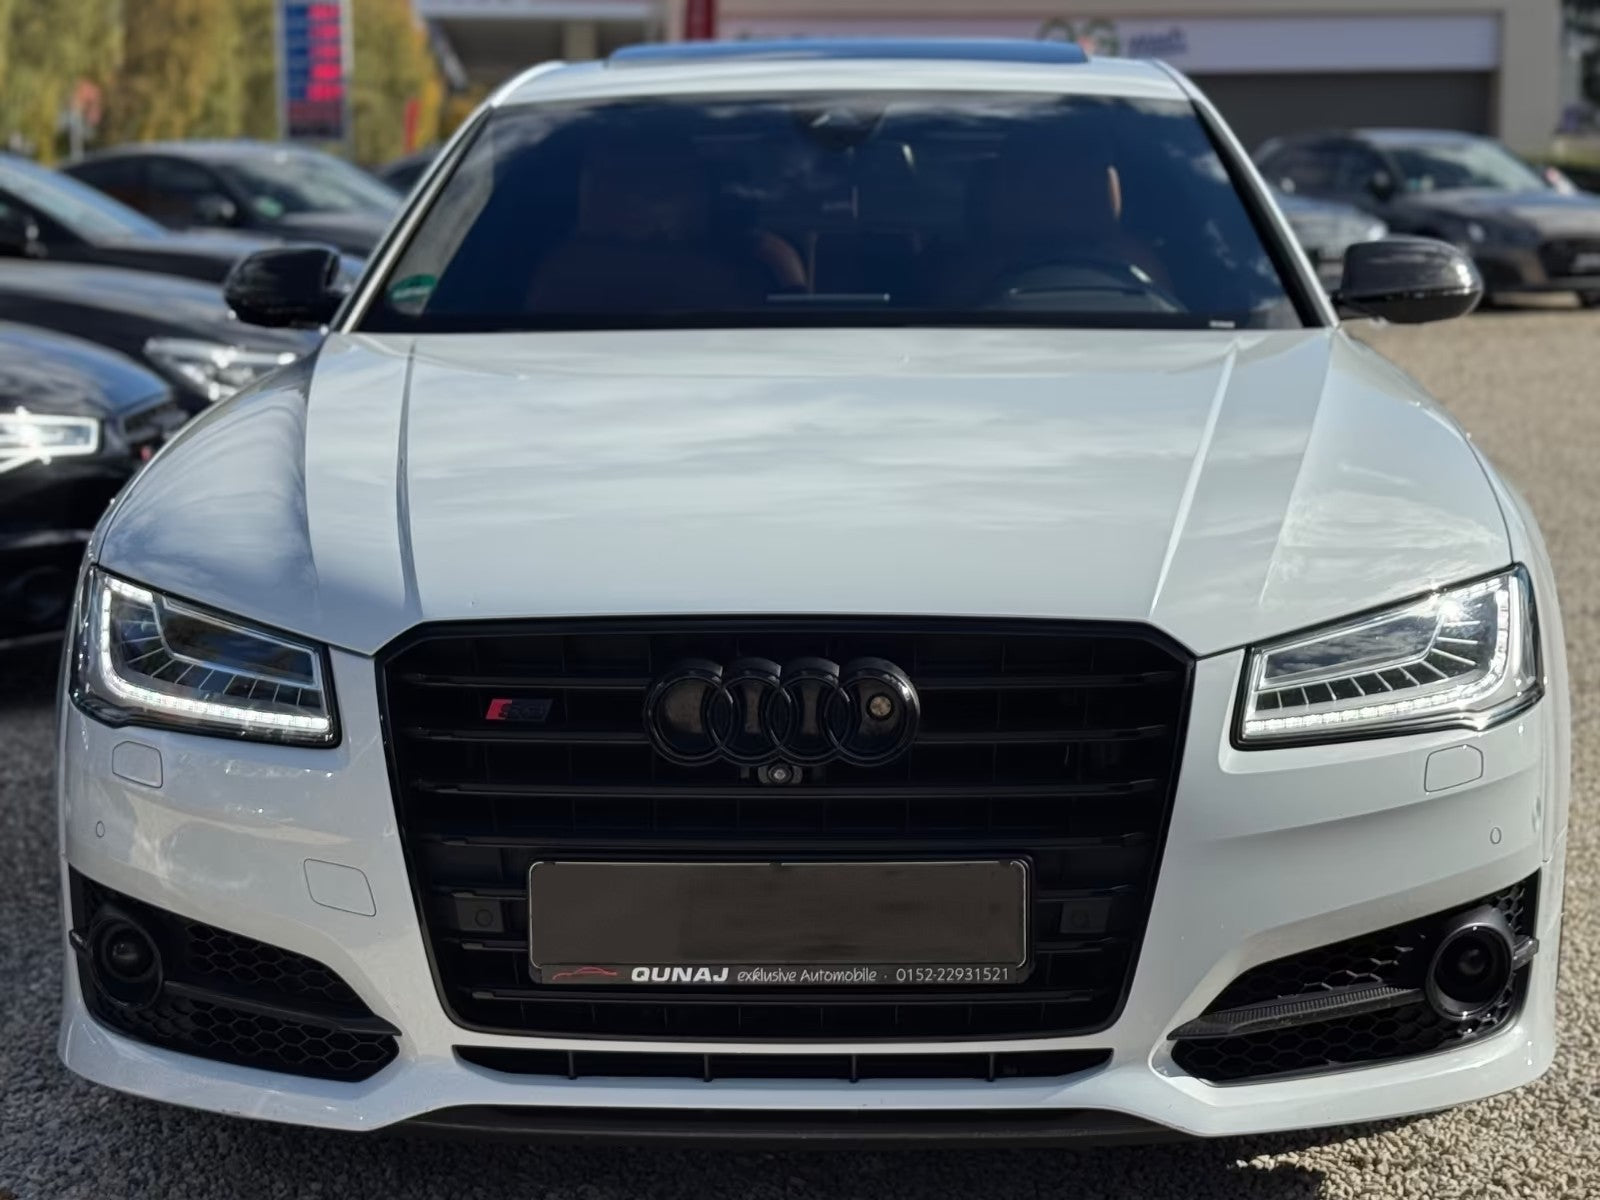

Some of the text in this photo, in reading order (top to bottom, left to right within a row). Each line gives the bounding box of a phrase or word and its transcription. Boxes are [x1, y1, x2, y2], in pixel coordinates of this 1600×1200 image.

[630, 966, 1009, 984] QUNAJ exklusive Automobile 0152-22931521
